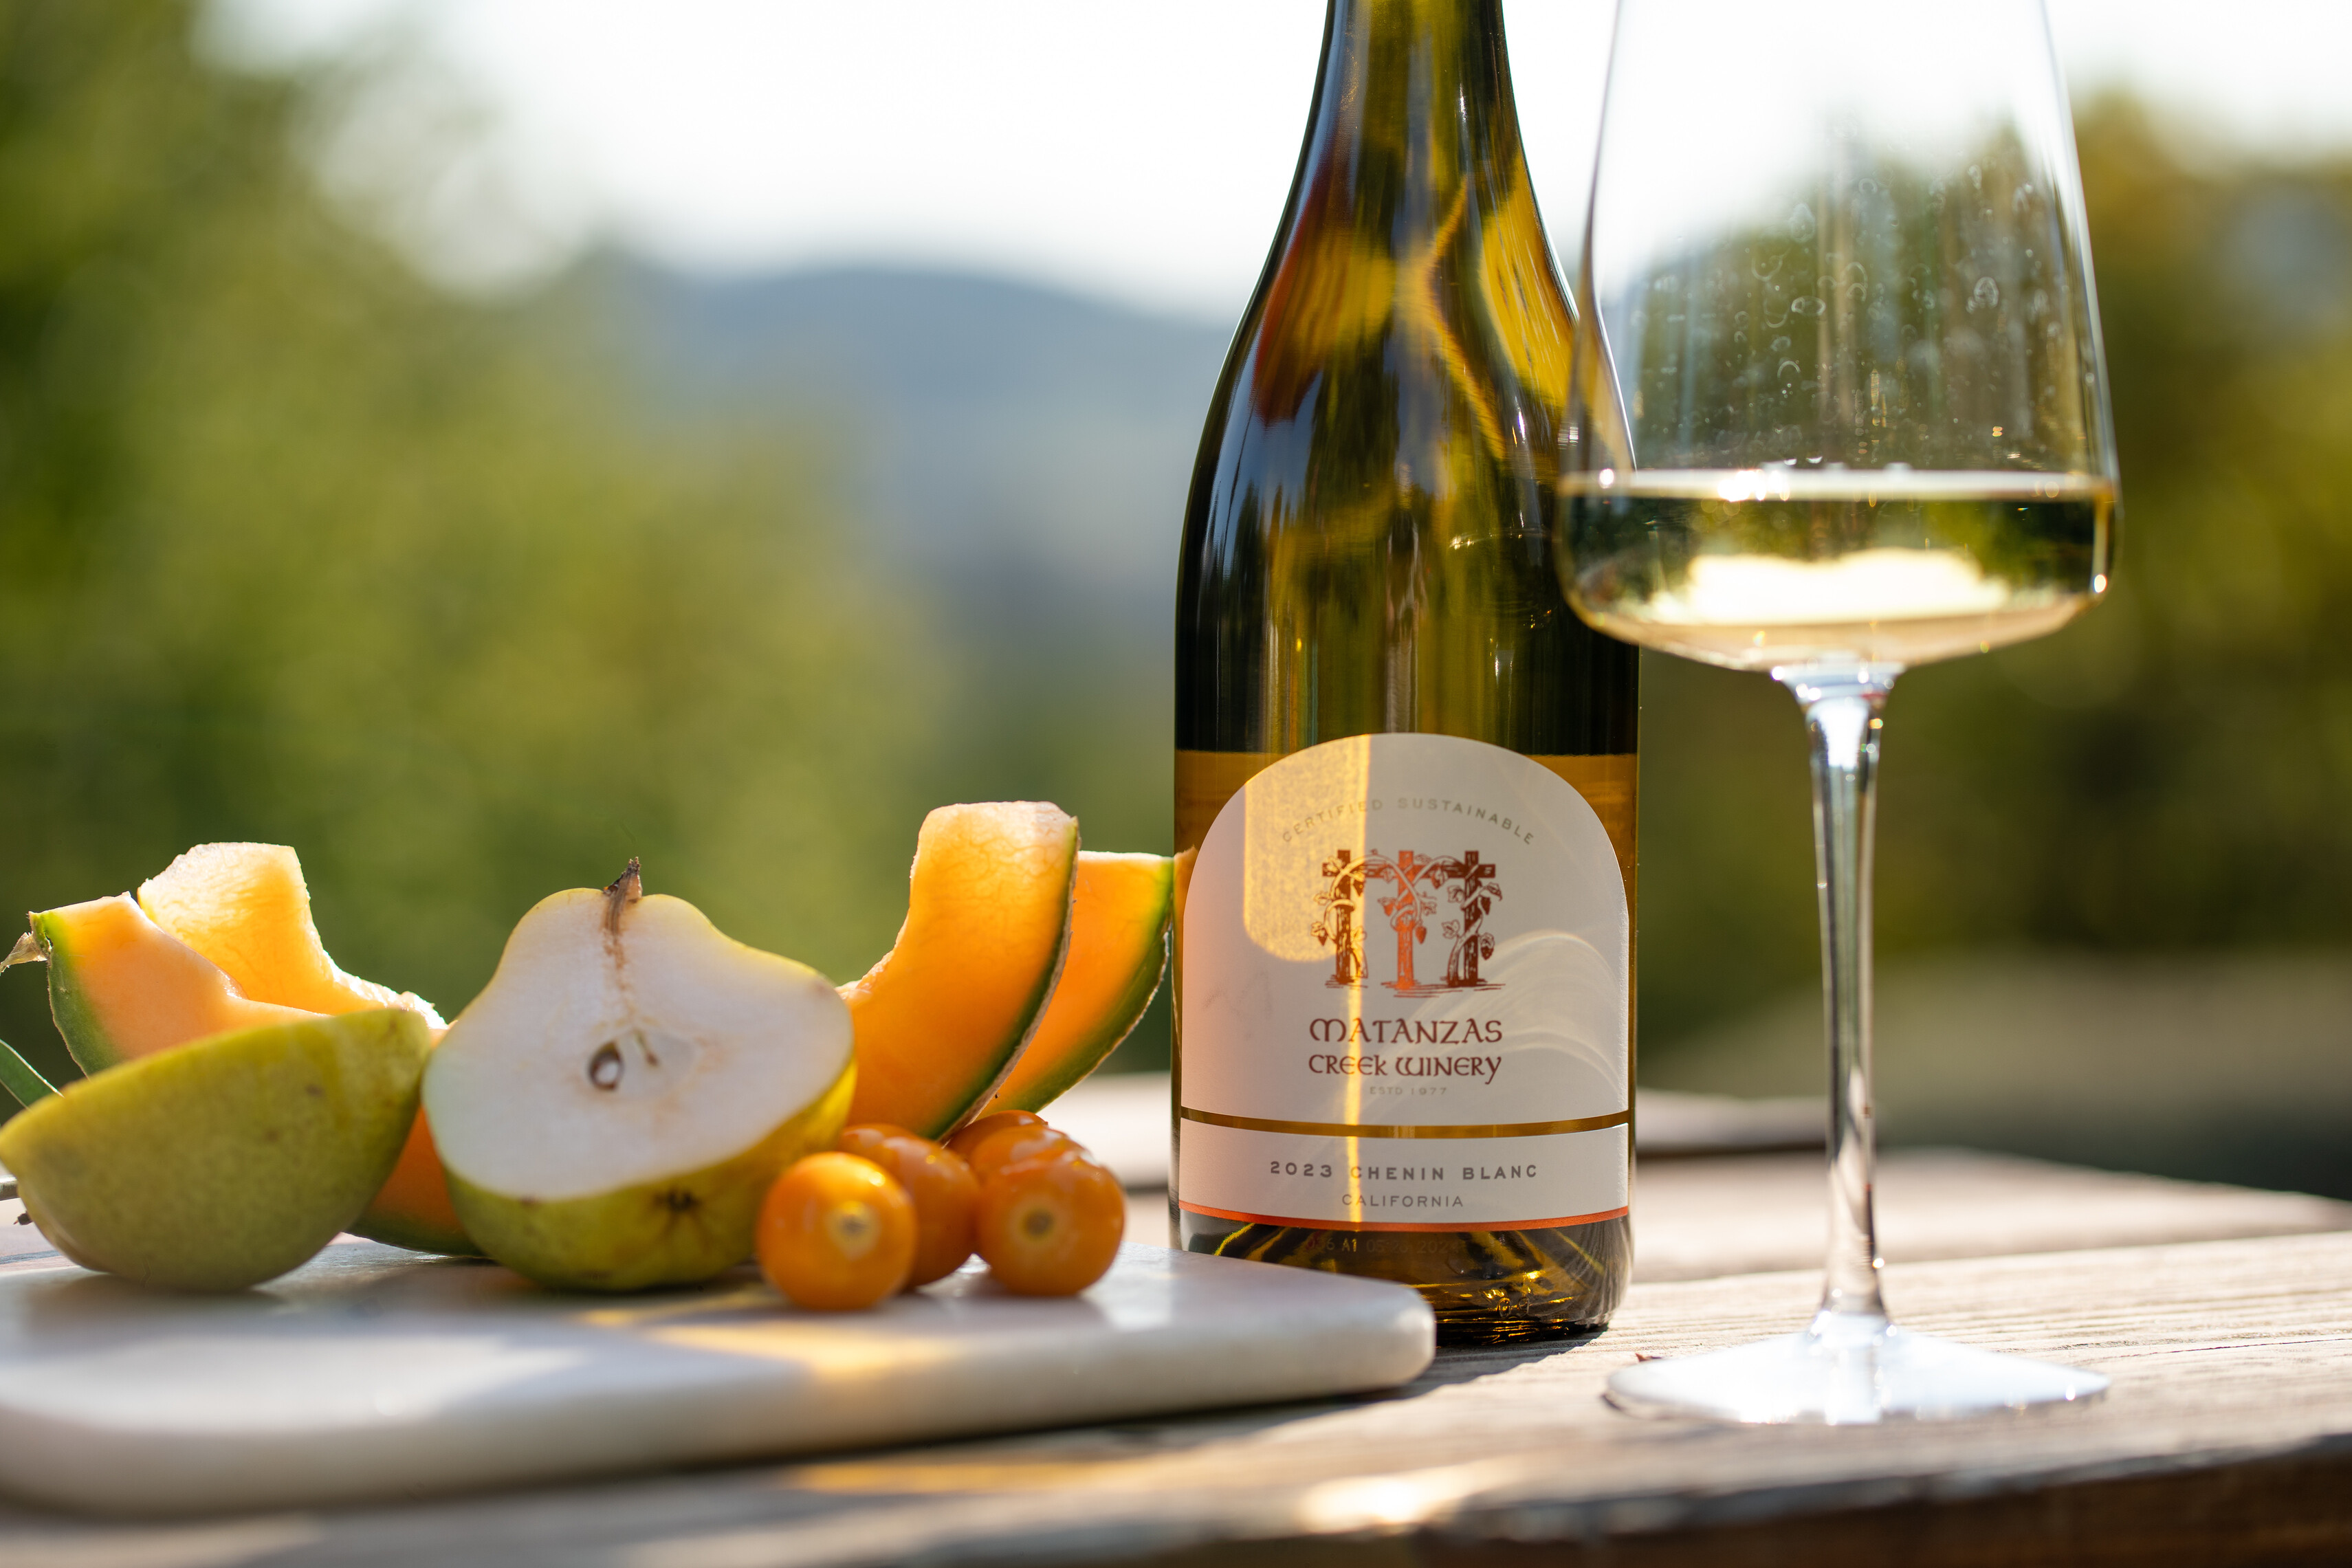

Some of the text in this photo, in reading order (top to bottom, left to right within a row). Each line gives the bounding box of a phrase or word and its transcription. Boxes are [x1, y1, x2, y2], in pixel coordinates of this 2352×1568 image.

[1282, 797, 1534, 845] CERTIFIED SUSTAINABLE
[1309, 1017, 1503, 1045] MATANZAS
[1395, 1056, 1502, 1085] WINERY
[1370, 1086, 1448, 1096] ESTD 1977
[1270, 1160, 1537, 1181] 2023 CHENIN BLANC
[1341, 1194, 1464, 1208] CALIFORNIA
